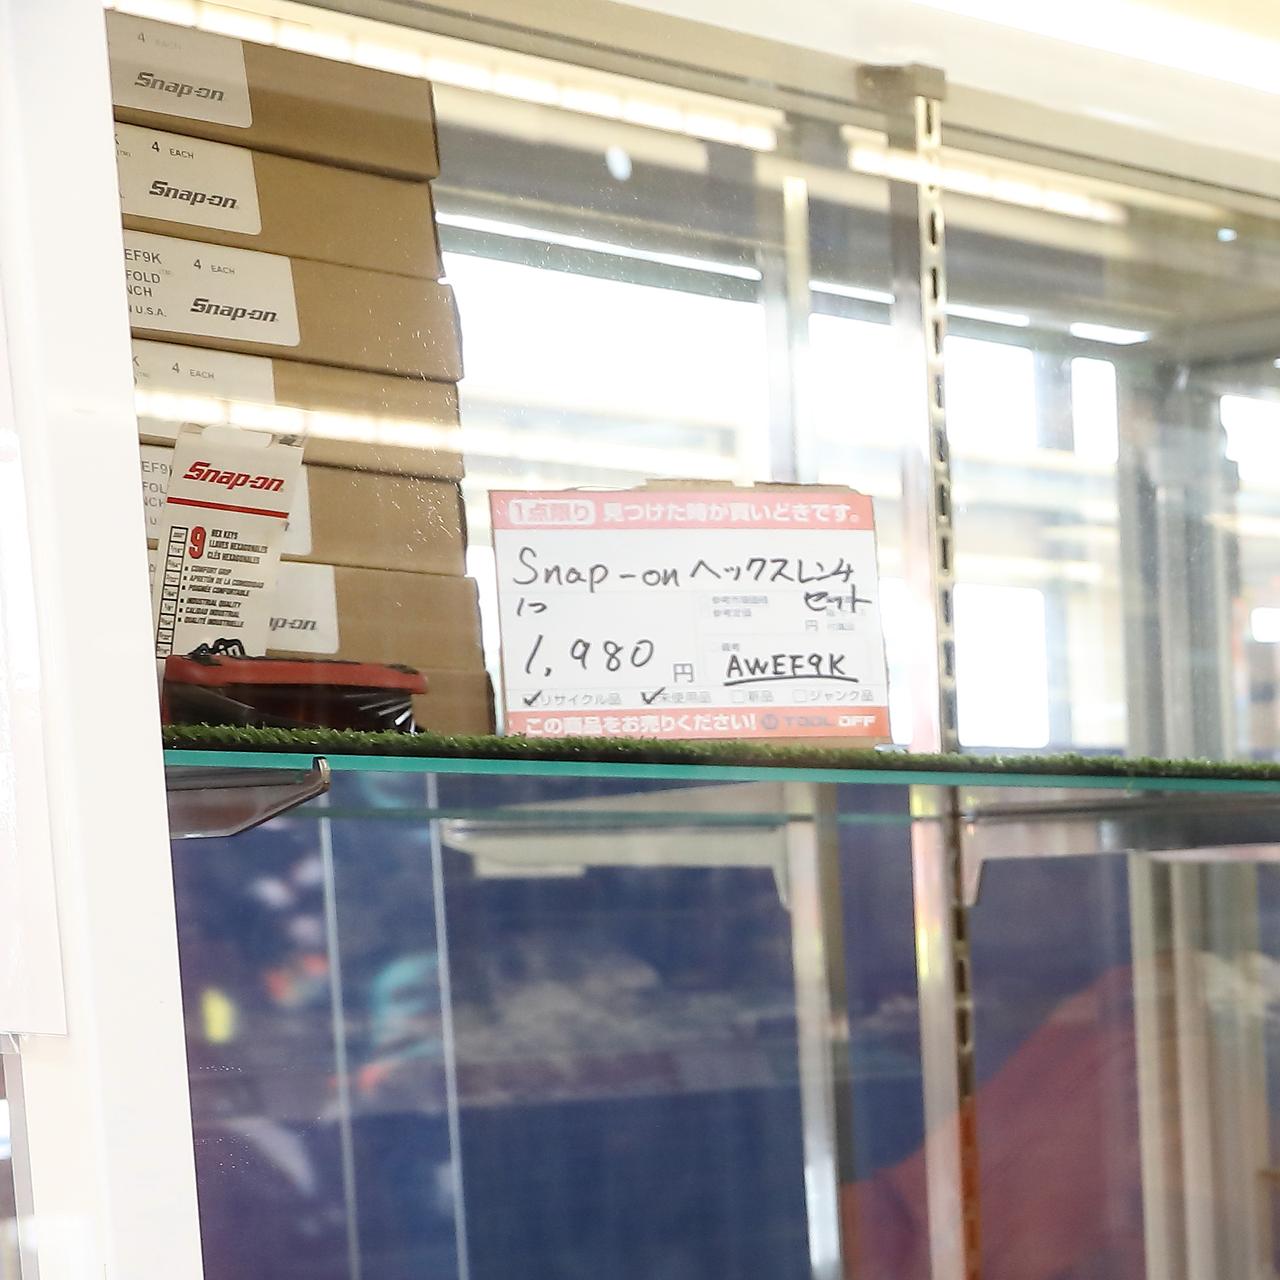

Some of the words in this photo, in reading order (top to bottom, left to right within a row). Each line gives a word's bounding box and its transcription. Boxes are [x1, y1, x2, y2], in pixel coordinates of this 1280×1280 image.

[134, 71, 225, 102] Snap-on
[151, 141, 160, 153] 4
[169, 148, 194, 160] EACH
[149, 180, 239, 209] Snap-on
[193, 258, 202, 270] 4
[211, 264, 236, 275] EACH
[190, 297, 278, 322] Snap-on
[172, 362, 180, 374] 4
[190, 368, 215, 380] EACH
[182, 460, 285, 492] Snap-on
[188, 526, 207, 559] 9
[513, 546, 680, 594] Snap-on
[525, 634, 654, 677] 1,980
[673, 663, 695, 683] 円
[727, 652, 846, 679] AWEF9K
[837, 714, 876, 728] OFF
